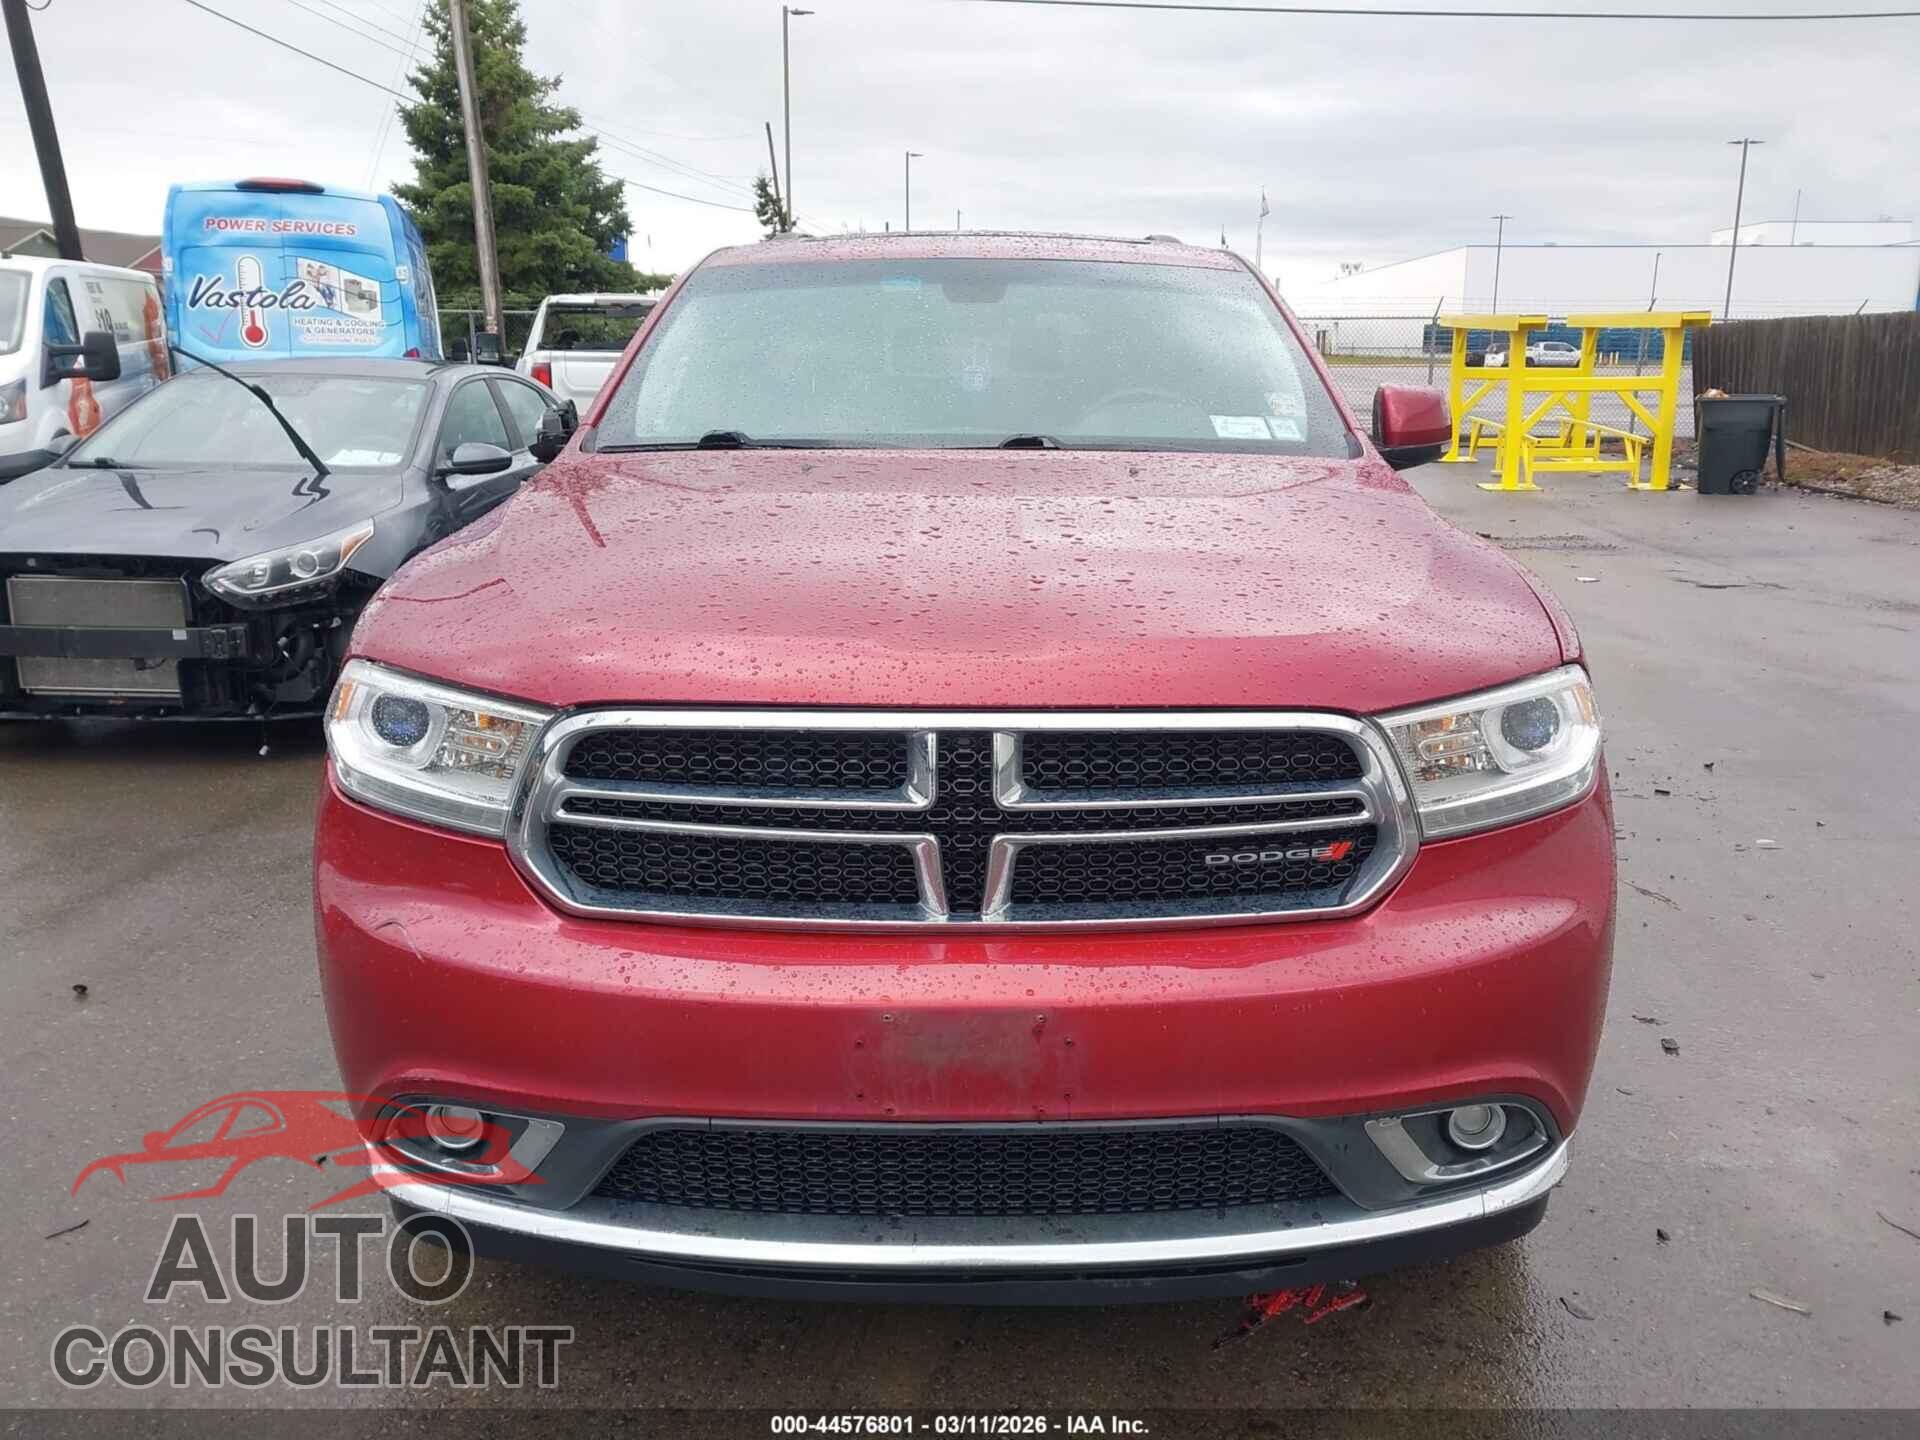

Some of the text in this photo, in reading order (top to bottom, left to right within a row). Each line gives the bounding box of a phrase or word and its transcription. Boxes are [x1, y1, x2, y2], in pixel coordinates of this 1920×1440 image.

[205, 218, 356, 235] POWER SERVICES
[188, 276, 316, 310] Vastola
[295, 318, 333, 327] HEATING
[344, 319, 385, 328] COOLING
[312, 326, 375, 336] GENERATORS
[1205, 847, 1333, 865] DODGE
